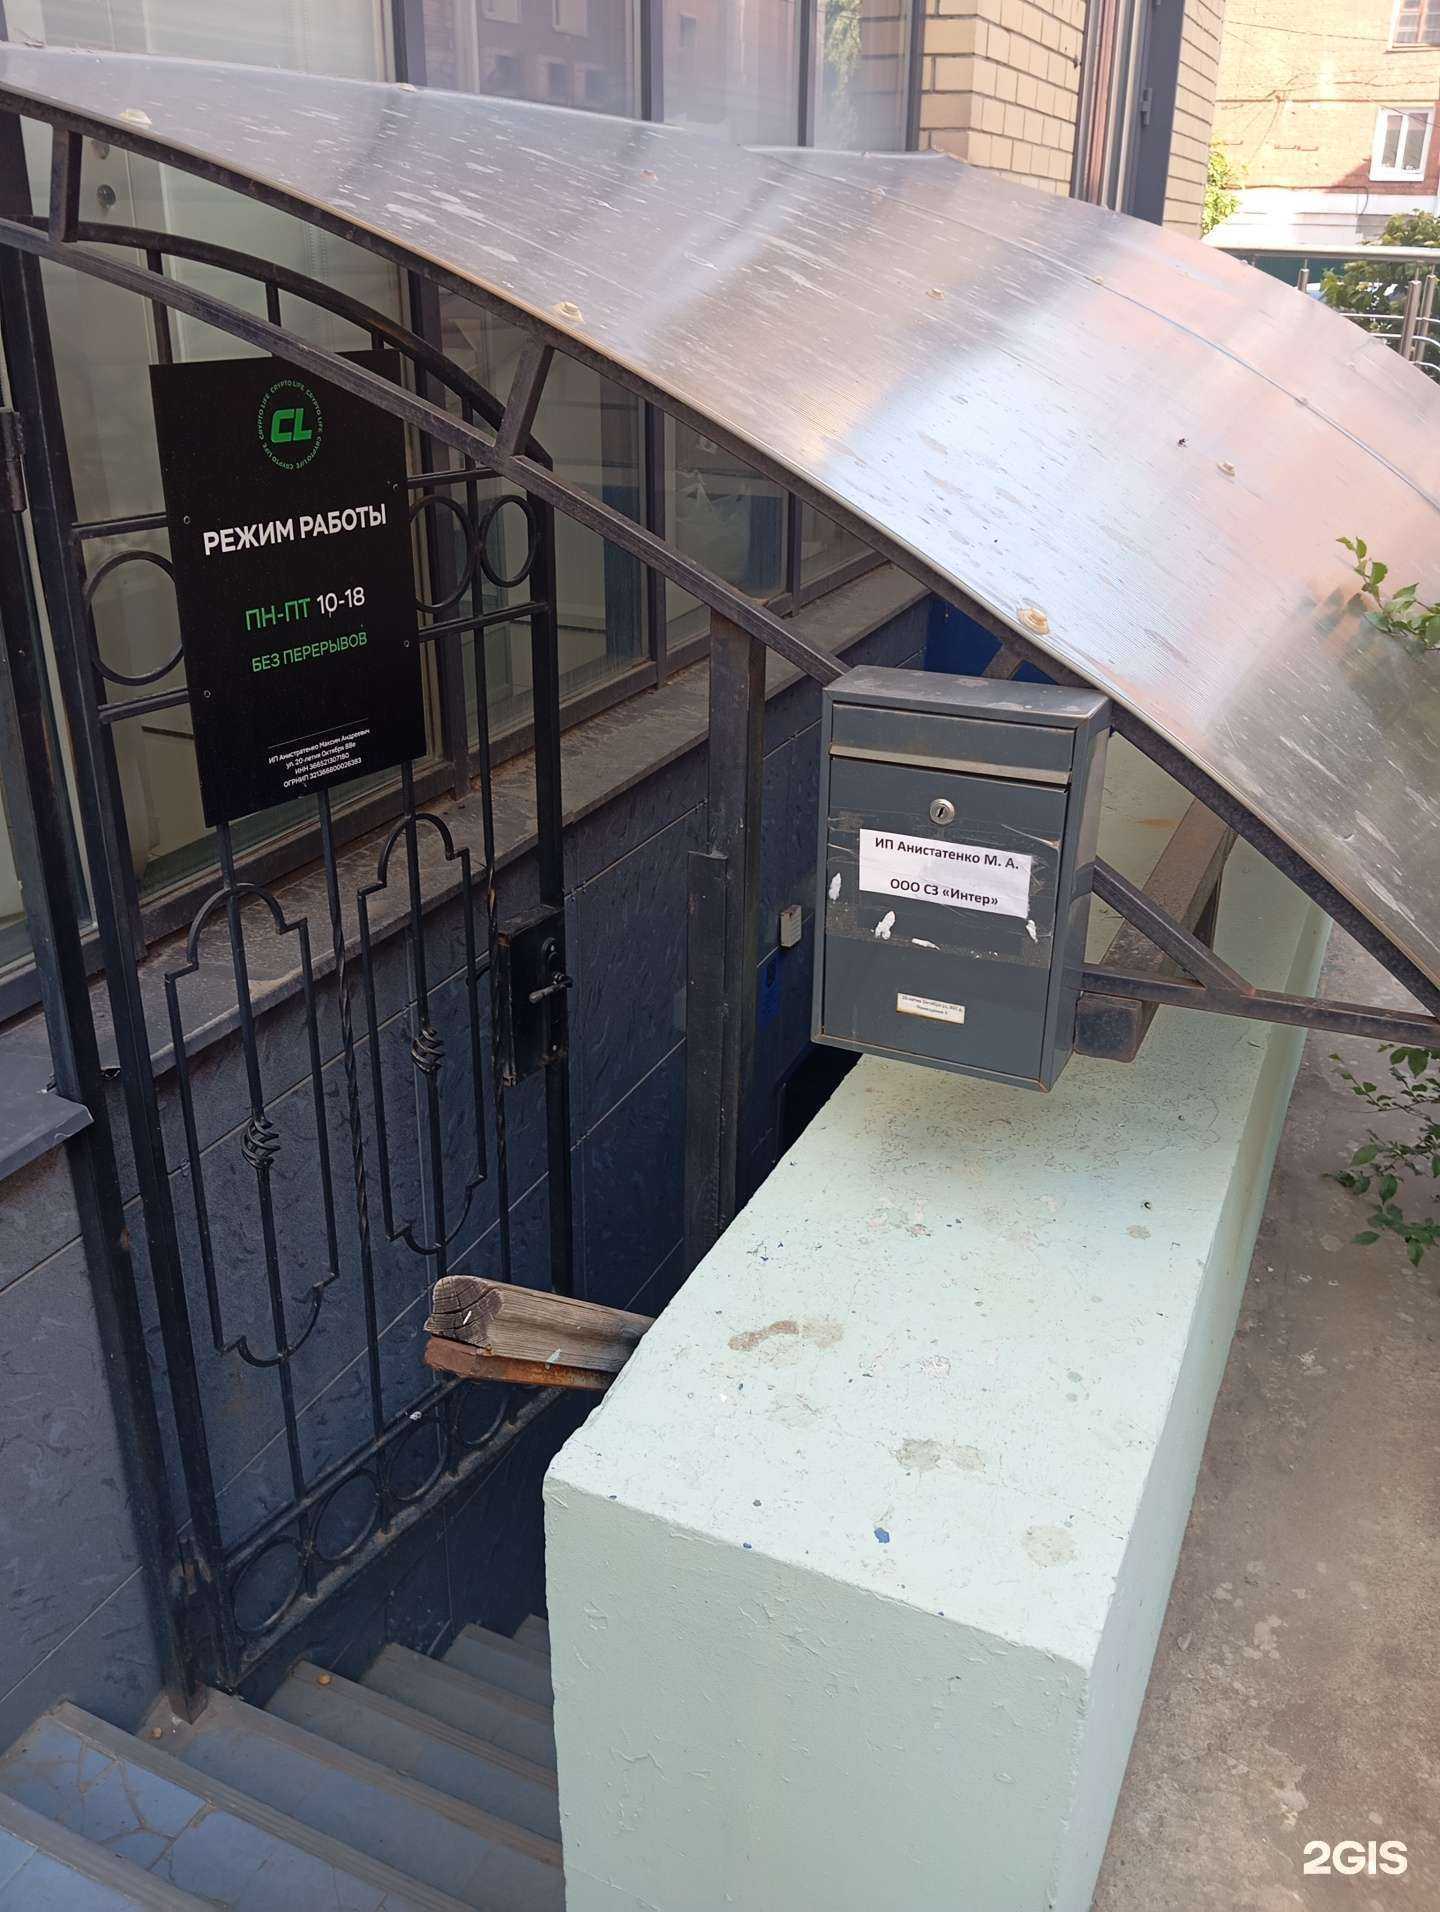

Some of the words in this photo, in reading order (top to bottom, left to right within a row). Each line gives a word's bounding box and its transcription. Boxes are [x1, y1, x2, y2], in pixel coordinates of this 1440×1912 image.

[271, 408, 312, 443] CL
[203, 518, 295, 556] РЕЖИМ
[299, 503, 387, 539] РАБОТЫ
[245, 597, 311, 631] ПН-ПТ
[316, 586, 366, 615] 10-18
[251, 652, 280, 673] БЕЗ
[283, 631, 368, 665] ПЕРЕРЫВОВ
[268, 755, 279, 764] ИП
[319, 737, 341, 749] Максим
[321, 746, 345, 759] Октября
[283, 774, 309, 788] ОГРНИП
[295, 765, 309, 775] ИНН
[875, 837, 894, 850] ИП
[897, 841, 981, 864] Анистатенко
[984, 854, 1001, 867] М.
[1005, 857, 1019, 870] А.
[890, 878, 920, 893] ООО
[923, 884, 939, 896] СЗ
[942, 888, 999, 907] «Интер»
